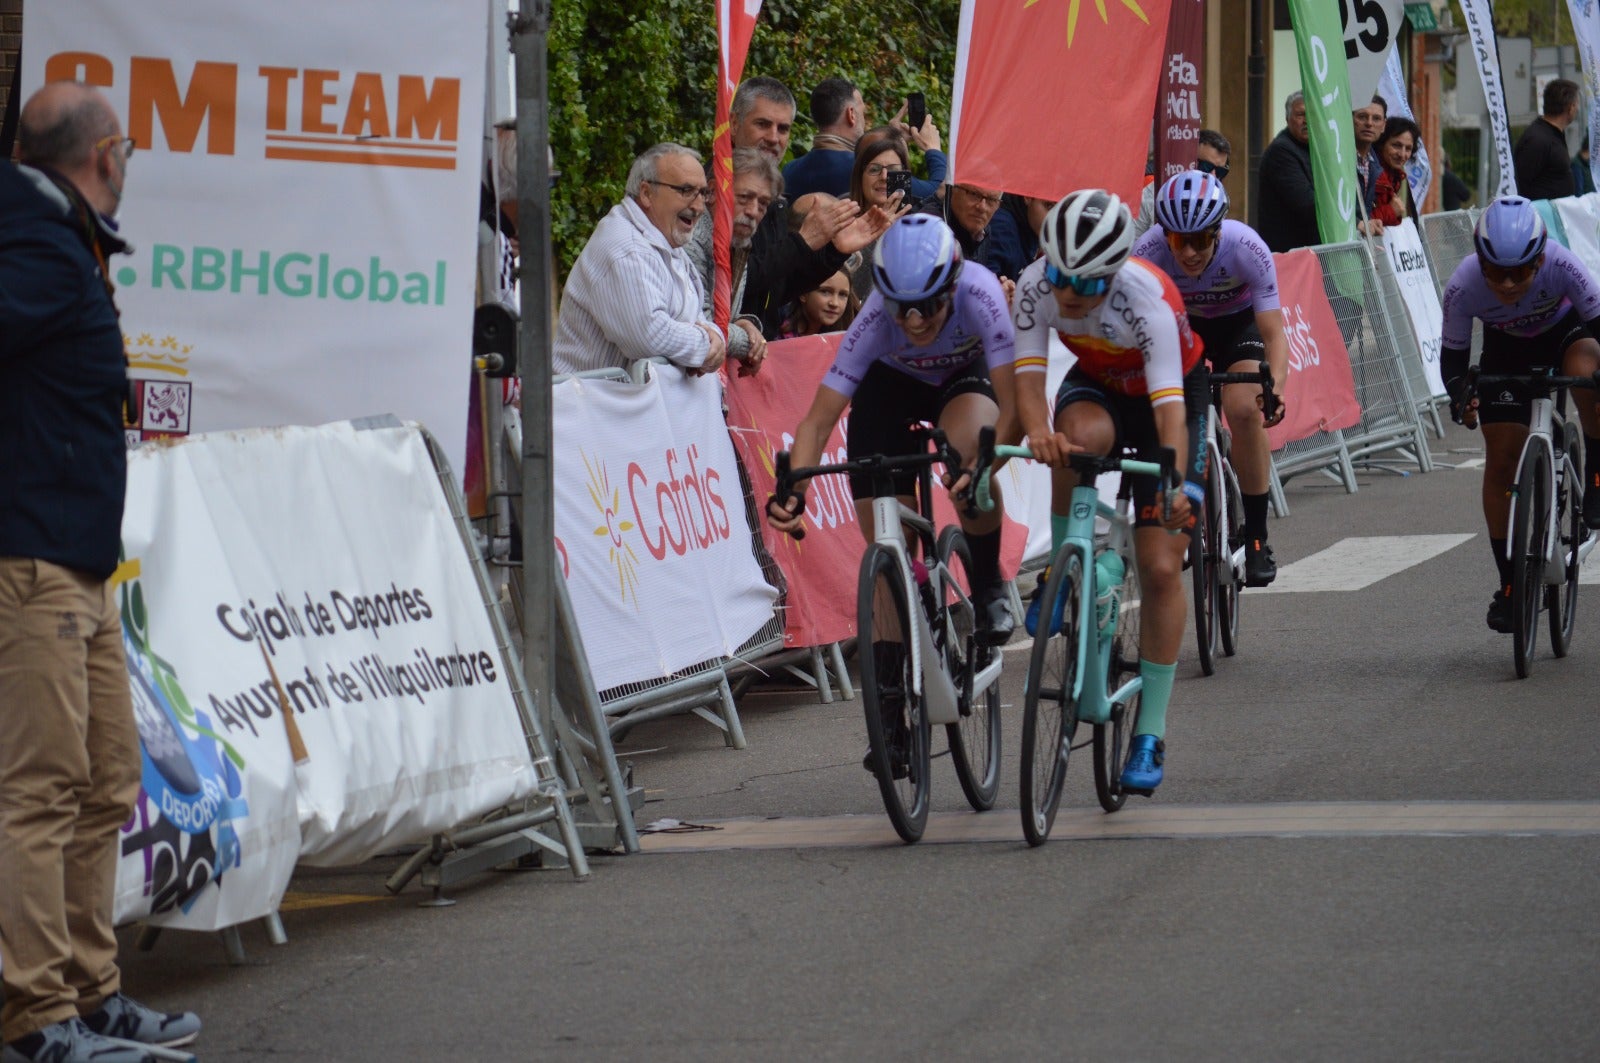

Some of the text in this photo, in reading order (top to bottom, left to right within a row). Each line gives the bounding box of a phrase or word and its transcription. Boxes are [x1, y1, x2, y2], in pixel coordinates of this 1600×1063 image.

[258, 66, 460, 140] TEAM
[1134, 239, 1159, 257] ORAL
[1239, 236, 1272, 273] LABORAL
[151, 244, 447, 305] RBHGlobal
[1554, 258, 1588, 290] LABORAL
[969, 284, 1003, 324] LABORAL
[843, 307, 882, 353] LABORAL
[627, 443, 730, 561] Cofidis
[304, 591, 335, 636] de
[330, 582, 432, 639] Deportes
[326, 662, 363, 704] de
